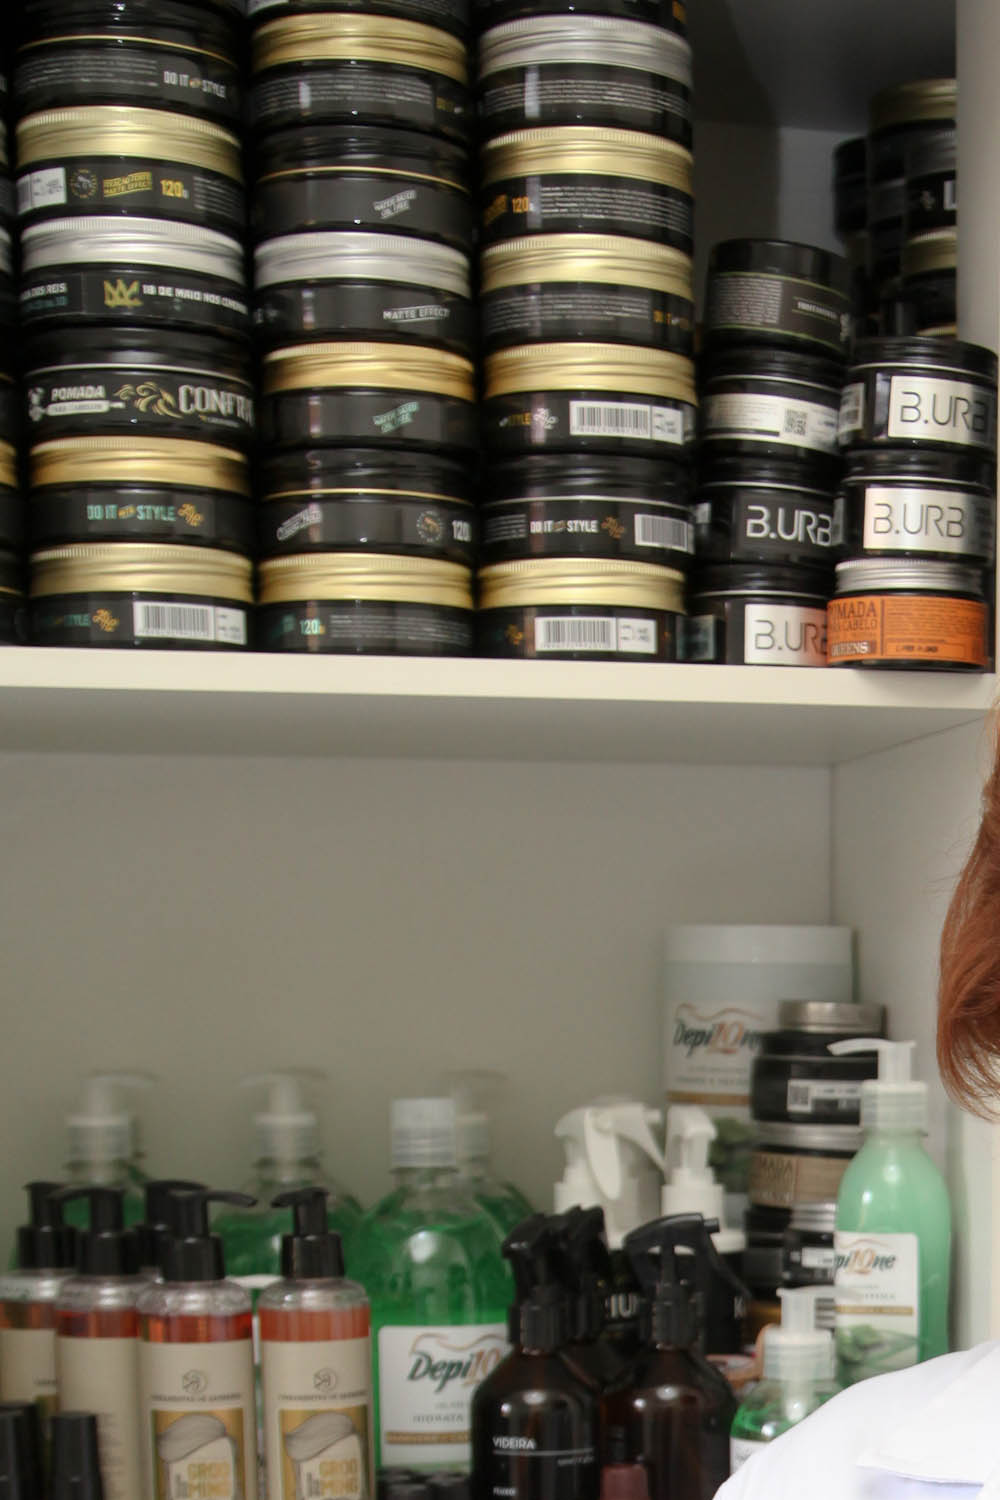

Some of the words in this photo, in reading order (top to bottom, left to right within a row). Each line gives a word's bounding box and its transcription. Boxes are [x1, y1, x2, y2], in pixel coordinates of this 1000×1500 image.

[158, 285, 174, 298] DE
[51, 385, 107, 401] POMADA
[87, 504, 104, 521] DO
[105, 504, 118, 520] IT
[136, 504, 176, 522] STYLE
[873, 502, 965, 538] B.URB
[530, 520, 543, 534] DO
[543, 520, 553, 534] IT
[566, 519, 599, 534] STYLE
[492, 1436, 536, 1451] VIDEIRA
